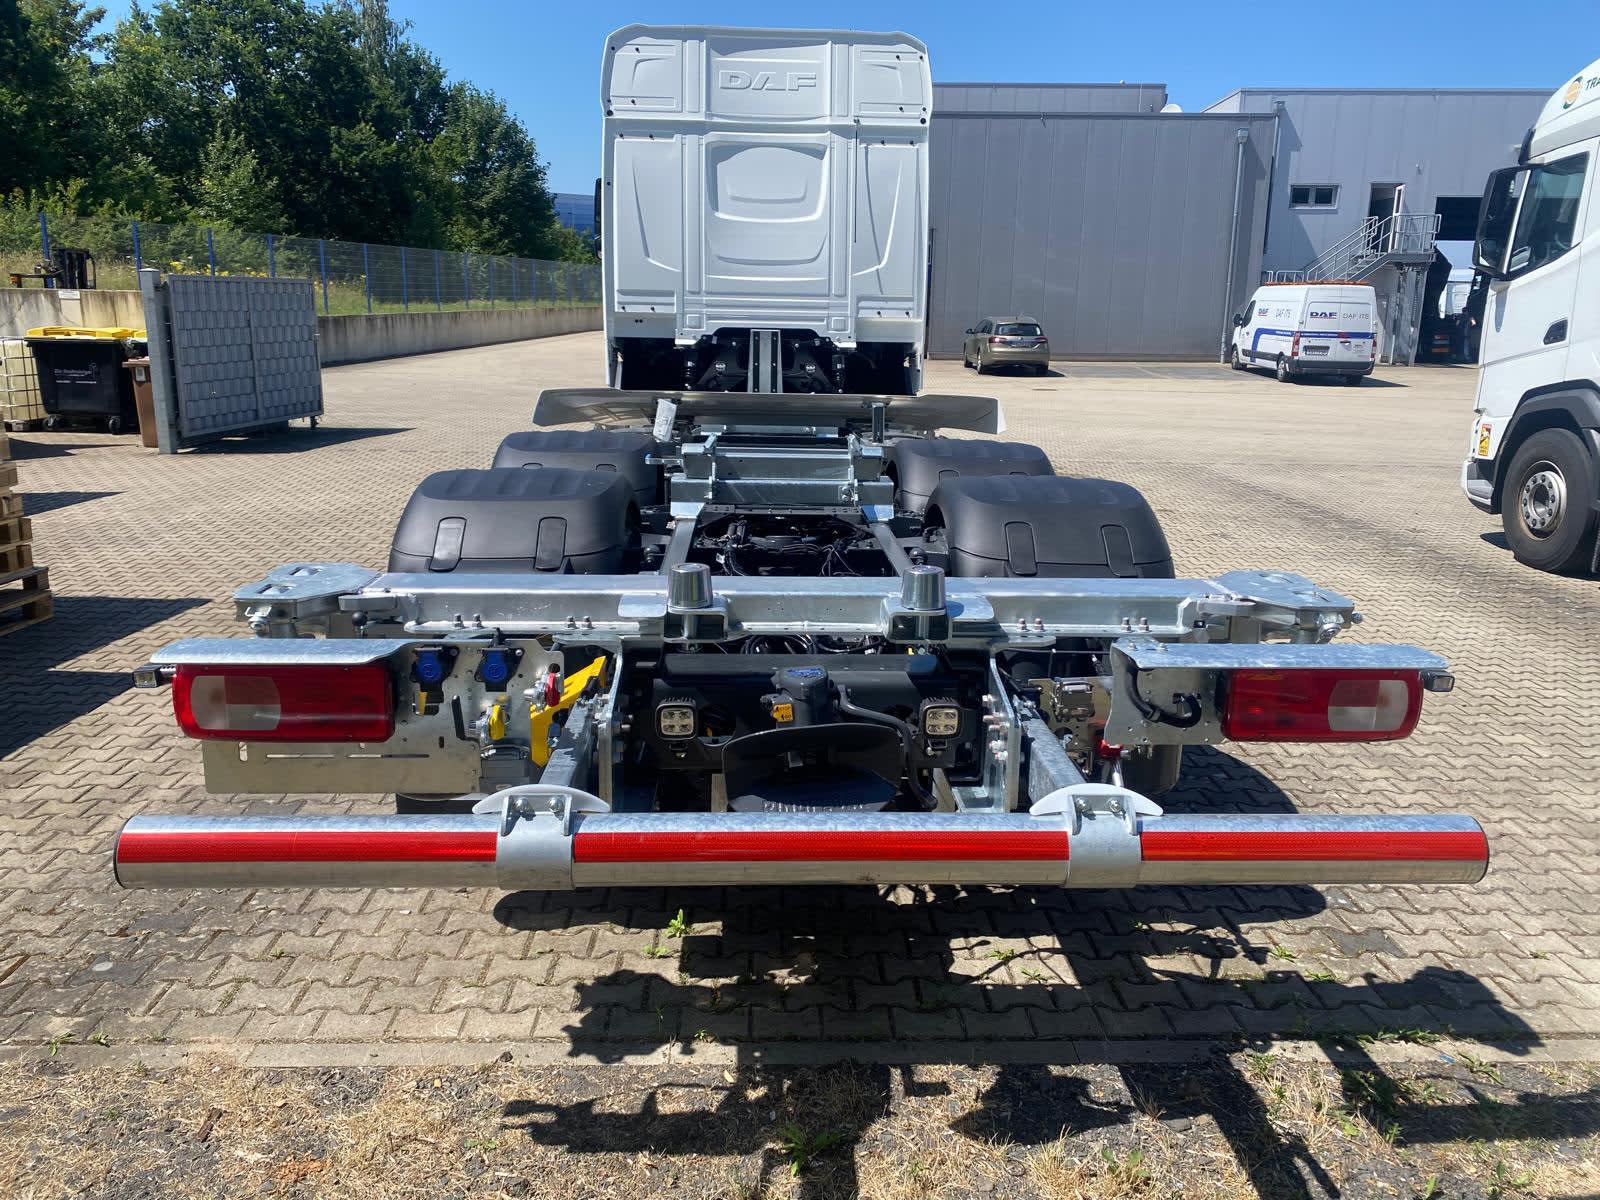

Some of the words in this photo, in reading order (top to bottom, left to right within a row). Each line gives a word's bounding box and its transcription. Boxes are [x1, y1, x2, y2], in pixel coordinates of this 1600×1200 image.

[719, 69, 817, 92] DAF
[1258, 308, 1269, 317] DAF
[1310, 311, 1337, 319] DAF
